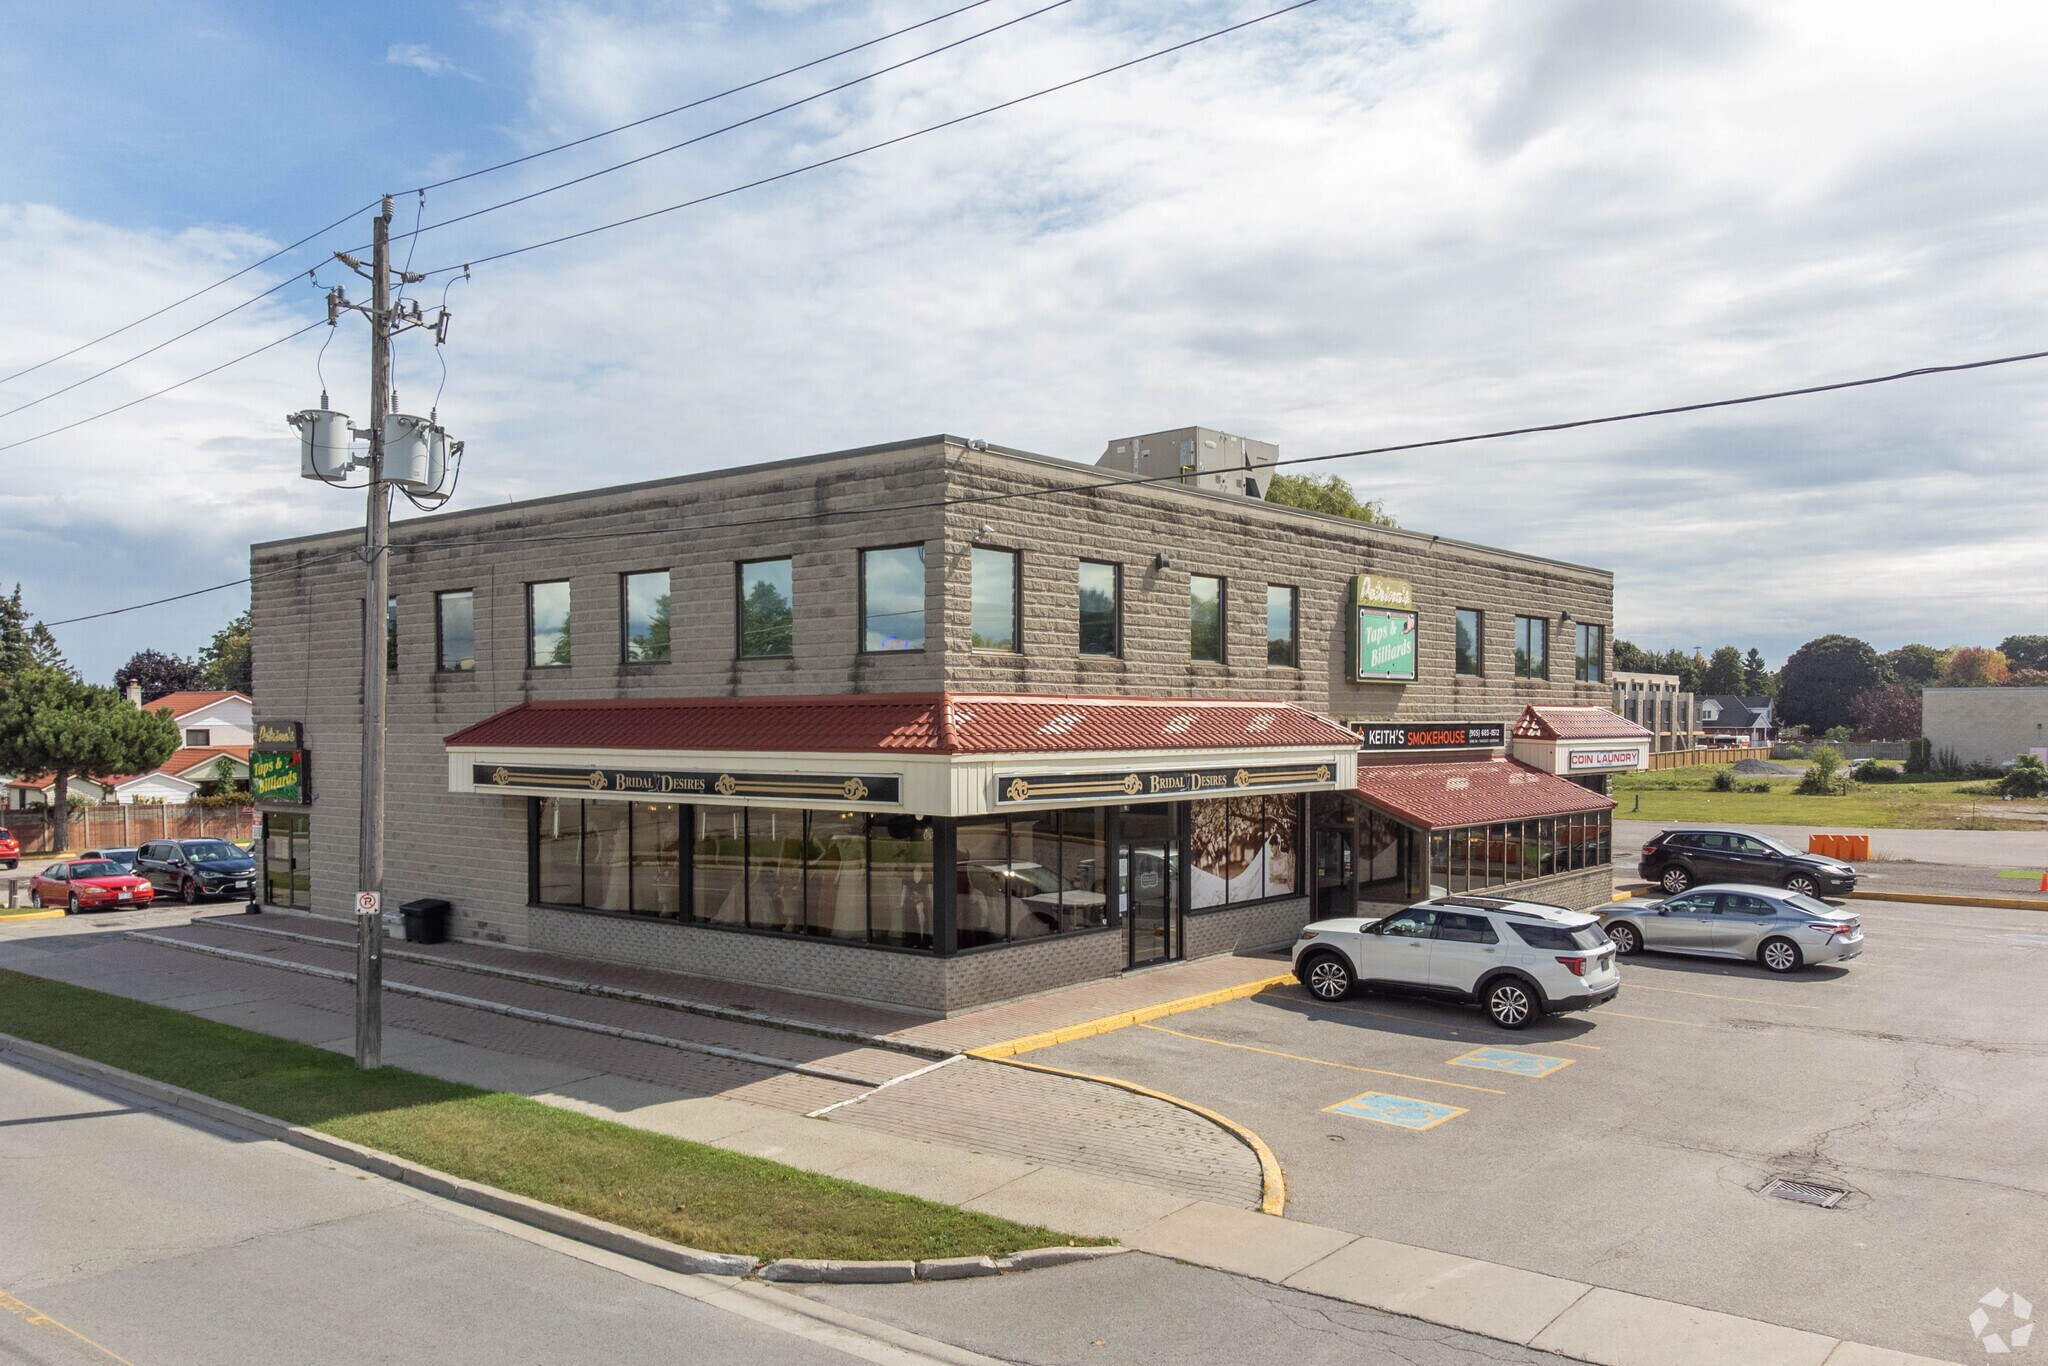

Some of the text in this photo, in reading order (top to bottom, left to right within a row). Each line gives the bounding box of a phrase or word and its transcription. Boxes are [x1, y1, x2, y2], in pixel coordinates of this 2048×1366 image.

[1365, 620, 1397, 645] Taps &
[1370, 638, 1412, 668] Billiards
[1368, 729, 1405, 745] KEITH'S
[1407, 730, 1466, 746] SMOKEHOUSE
[253, 757, 282, 777] Taps &
[1571, 753, 1637, 765] COIN LAUNDRY
[258, 770, 297, 794] Billiards
[615, 773, 706, 792] BRIDAL DESIRES
[1149, 773, 1227, 793] BRIDAL DESIRES
